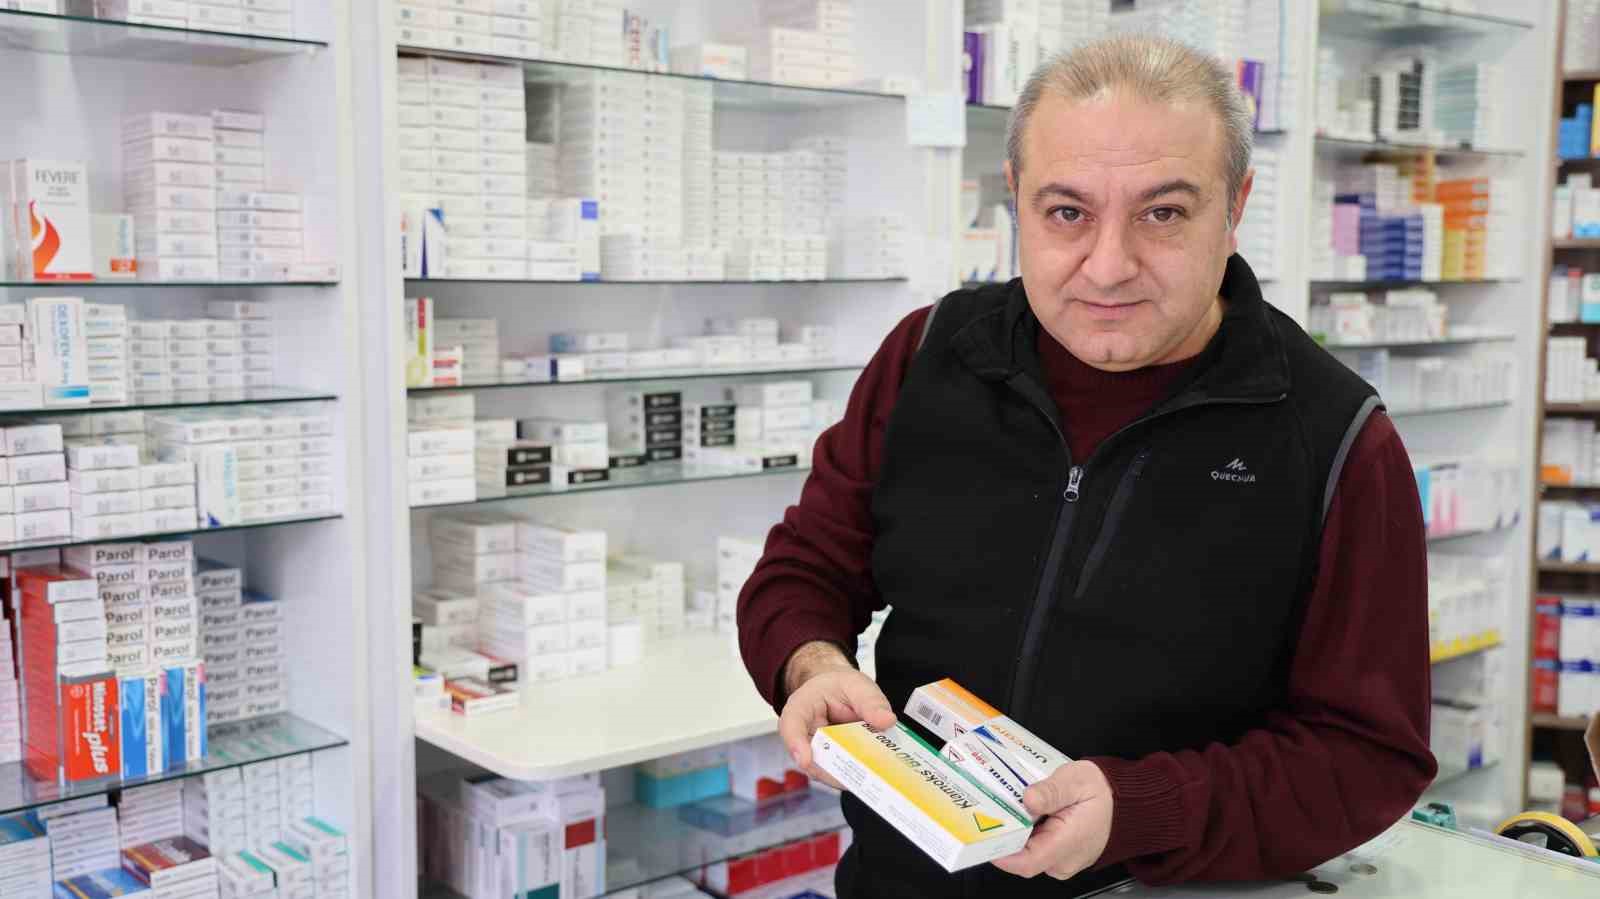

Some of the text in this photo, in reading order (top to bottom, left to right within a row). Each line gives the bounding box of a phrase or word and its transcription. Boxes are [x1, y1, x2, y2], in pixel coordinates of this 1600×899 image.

[95, 547, 135, 561] Parol
[148, 546, 186, 560] Parol
[96, 569, 135, 583] Parol
[148, 567, 185, 580] Parol
[202, 573, 235, 586] Parol
[102, 589, 141, 602] Parol
[150, 583, 187, 597] Parol
[105, 610, 143, 623] Parol
[154, 603, 190, 616] Parol
[106, 629, 143, 644] Parol
[154, 624, 191, 637] Parol
[154, 643, 190, 656] Parol
[148, 677, 158, 713] Parol
[875, 734, 901, 753] 1000
[82, 731, 110, 774] plus
[919, 769, 974, 809] Klamoks
